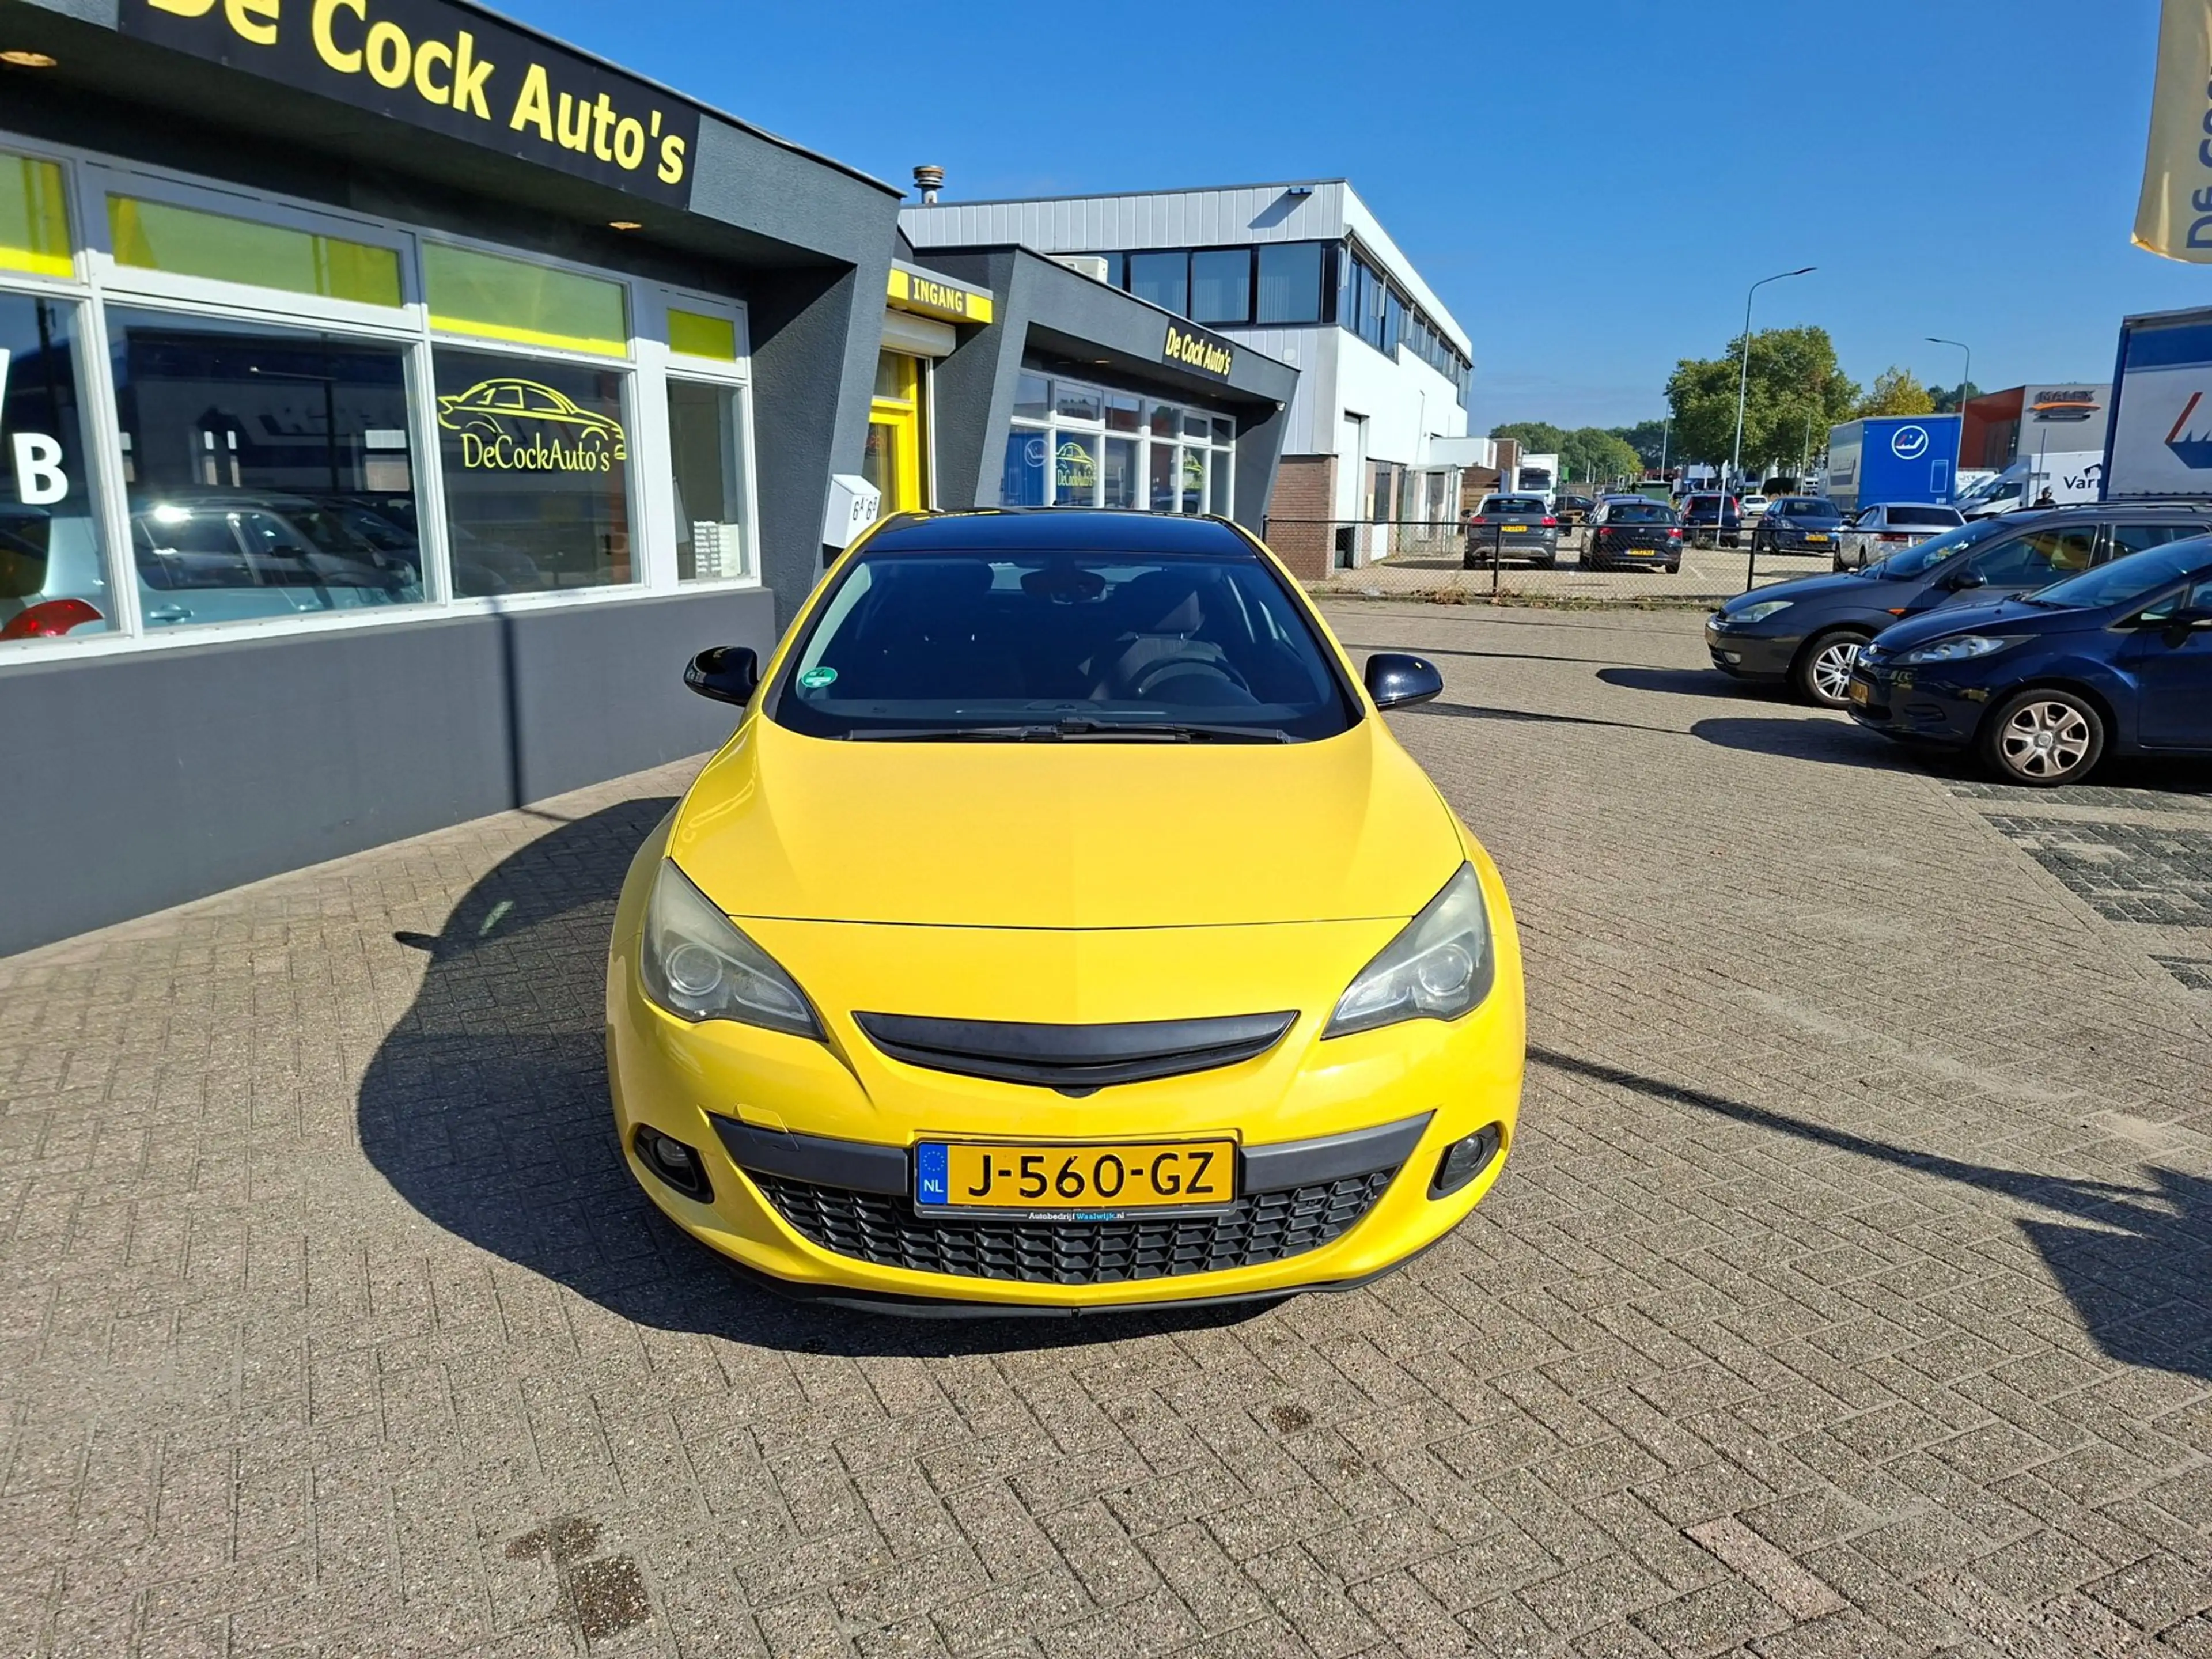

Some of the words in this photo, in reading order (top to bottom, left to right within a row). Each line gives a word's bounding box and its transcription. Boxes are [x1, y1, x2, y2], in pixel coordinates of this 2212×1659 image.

[147, 0, 279, 45] e
[312, 0, 494, 120] Cock
[509, 63, 685, 184] Auto's
[914, 278, 963, 312] INGANG
[1165, 327, 1181, 358] De
[1181, 334, 1205, 366] Cock
[1203, 343, 1231, 376] Auto's
[460, 432, 611, 472] DeCockAuto's
[923, 1179, 944, 1193] NL
[968, 1152, 1214, 1199] J-560-GZ
